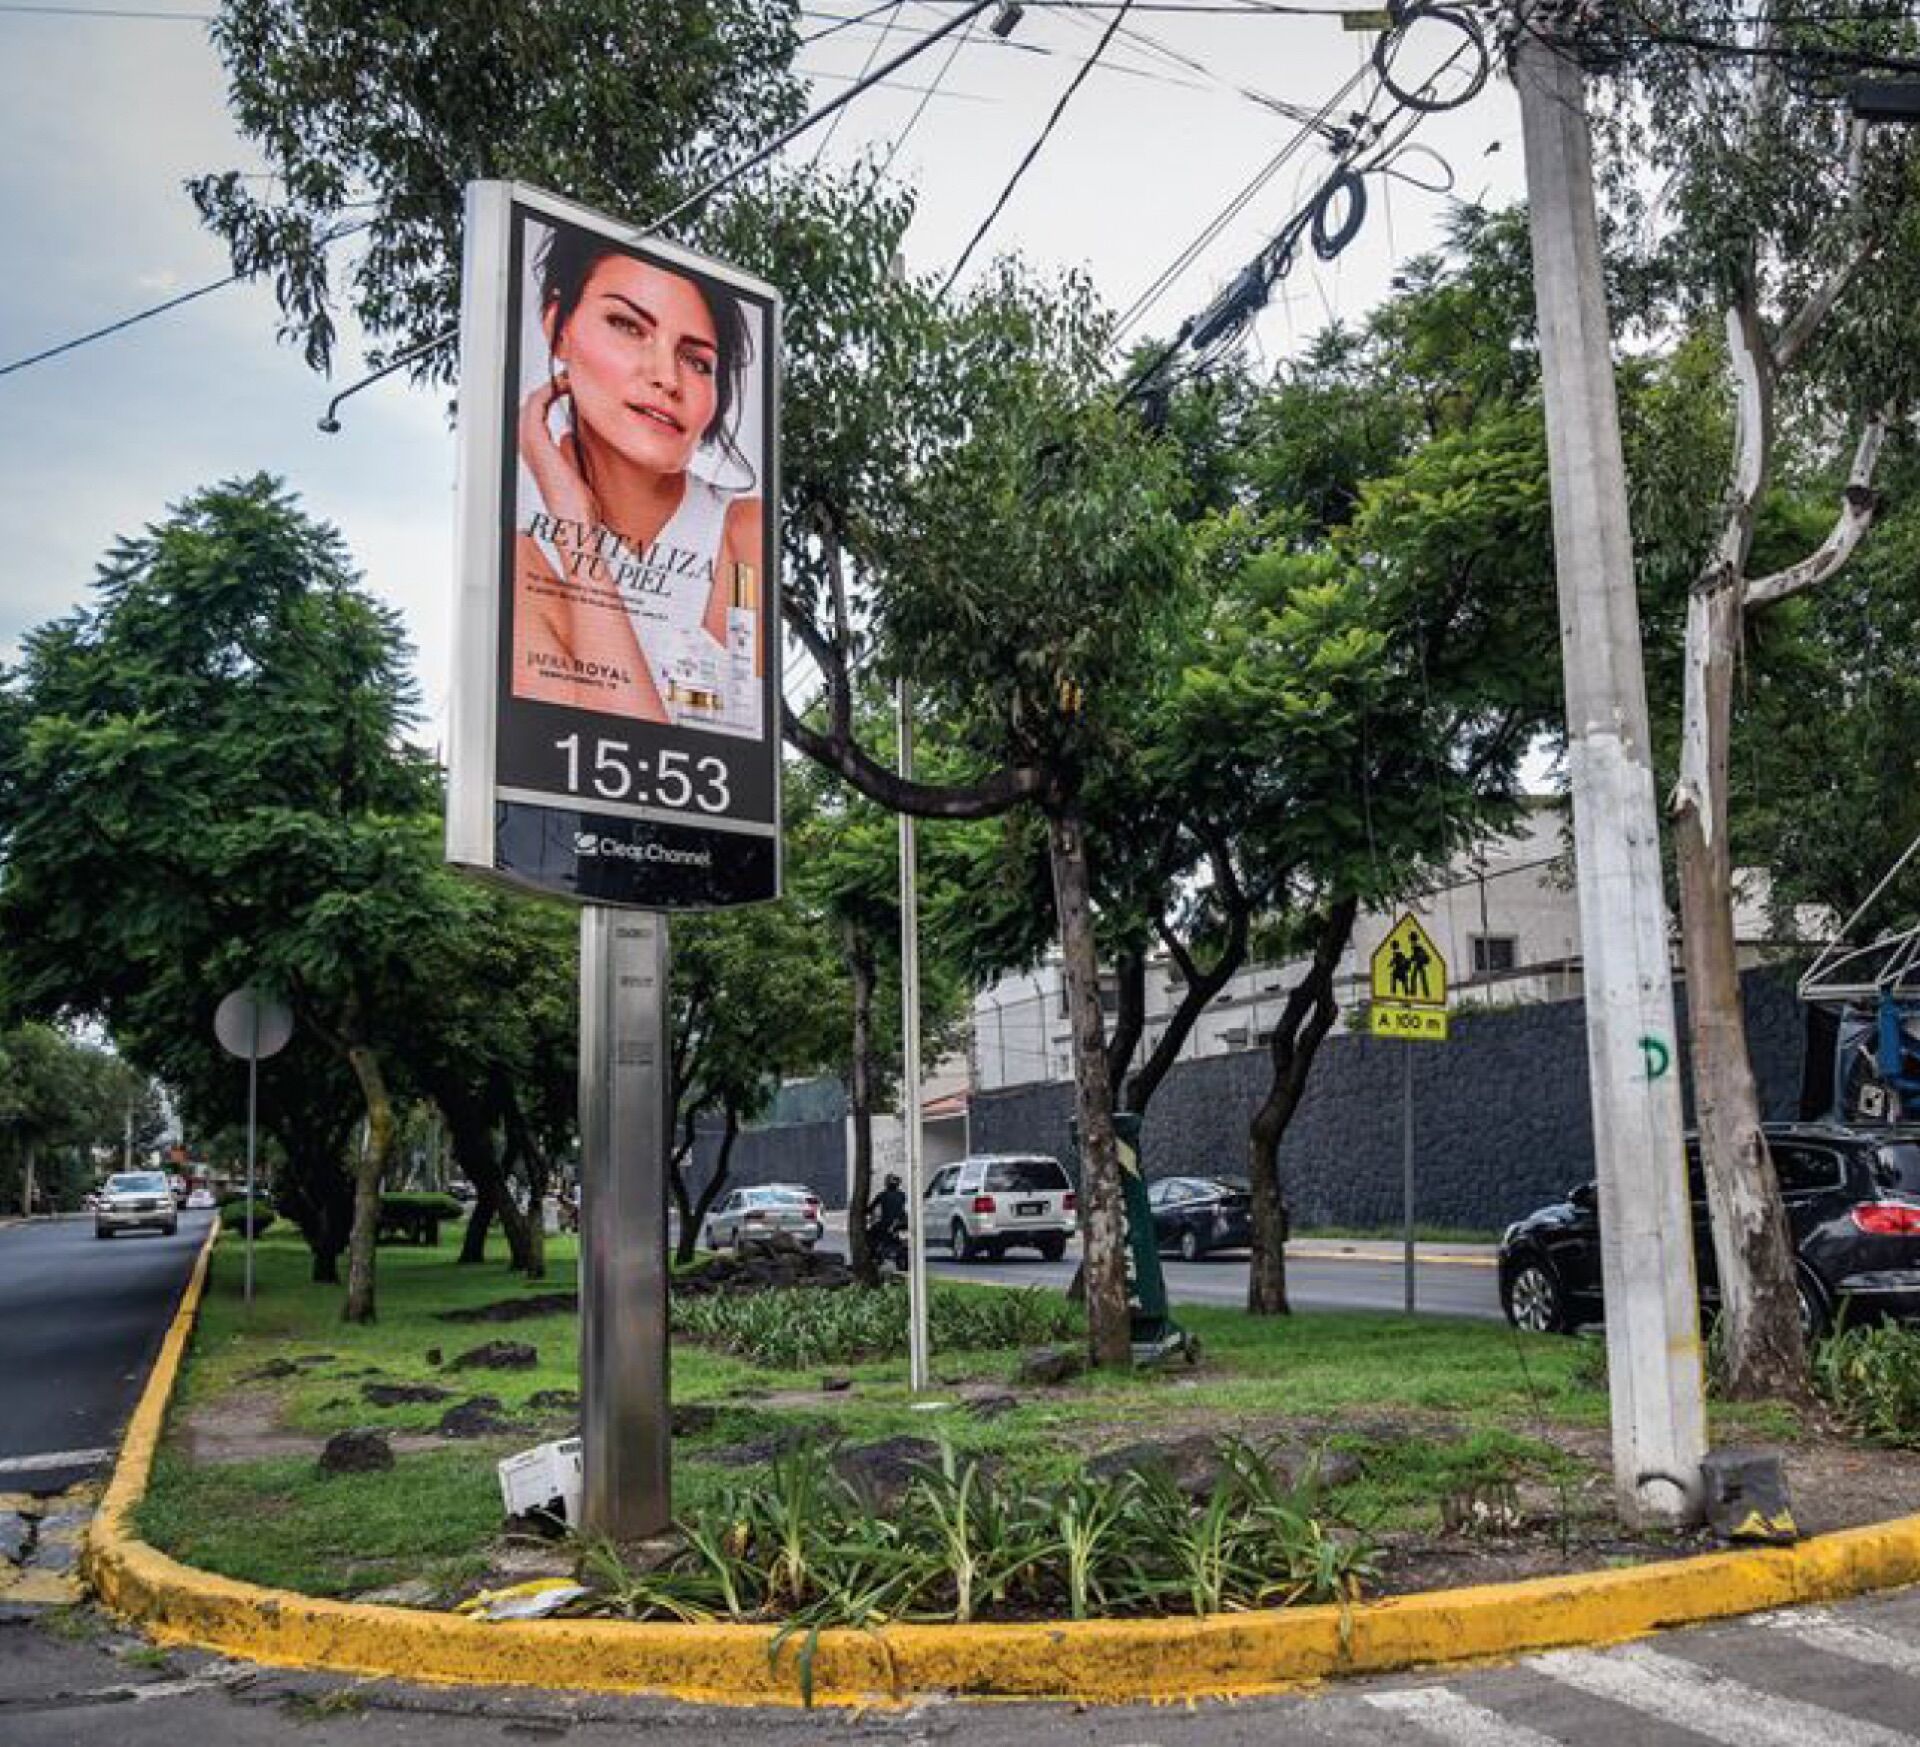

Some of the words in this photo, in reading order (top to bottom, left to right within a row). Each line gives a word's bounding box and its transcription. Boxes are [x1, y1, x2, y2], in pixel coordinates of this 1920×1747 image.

[526, 512, 715, 583] REVITALIZA
[570, 551, 605, 582] TU
[613, 562, 672, 597] PIEL
[573, 658, 632, 684] ROYAL
[554, 732, 731, 814] 15:53
[644, 843, 712, 867] Channel
[1377, 1012, 1391, 1028] A
[1395, 1013, 1422, 1029] 100
